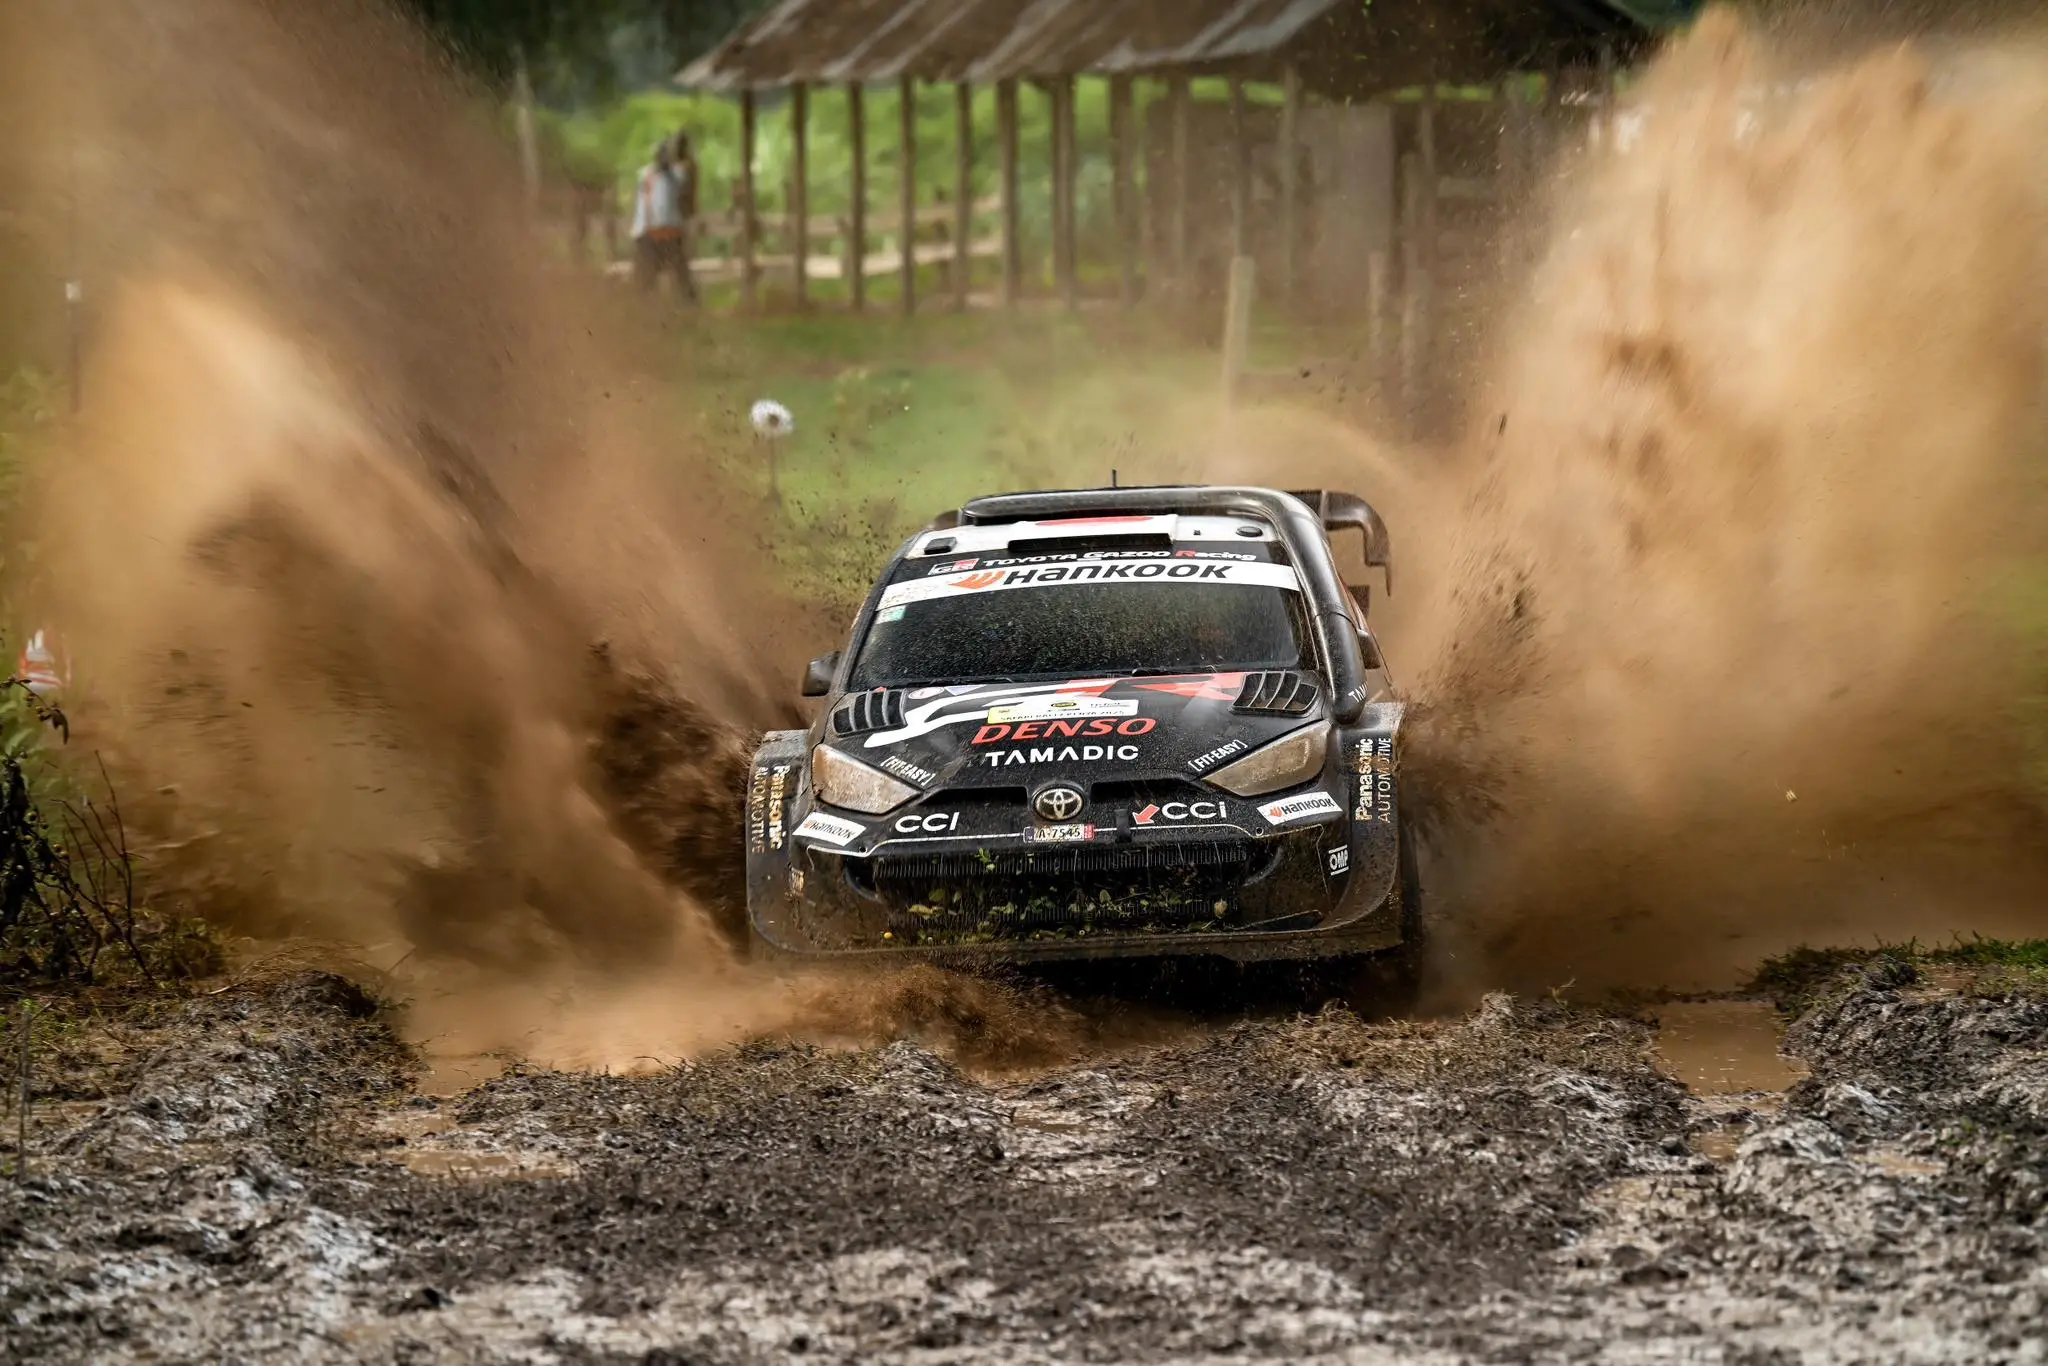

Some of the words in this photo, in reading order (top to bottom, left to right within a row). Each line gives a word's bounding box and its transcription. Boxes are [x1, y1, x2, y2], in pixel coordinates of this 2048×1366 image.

[983, 553, 1077, 567] TOYOTA
[1079, 551, 1171, 561] GAZOO
[1175, 550, 1257, 561] Racing
[971, 718, 1157, 744] DENSO
[985, 745, 1139, 767] TAMADIC
[1355, 738, 1373, 821] Panasonic
[1377, 737, 1392, 824] AUTOMOTIVE
[769, 765, 791, 850] Panasonic
[1162, 801, 1227, 819] CCI
[895, 812, 960, 833] CCI
[1329, 849, 1349, 870] OMP
